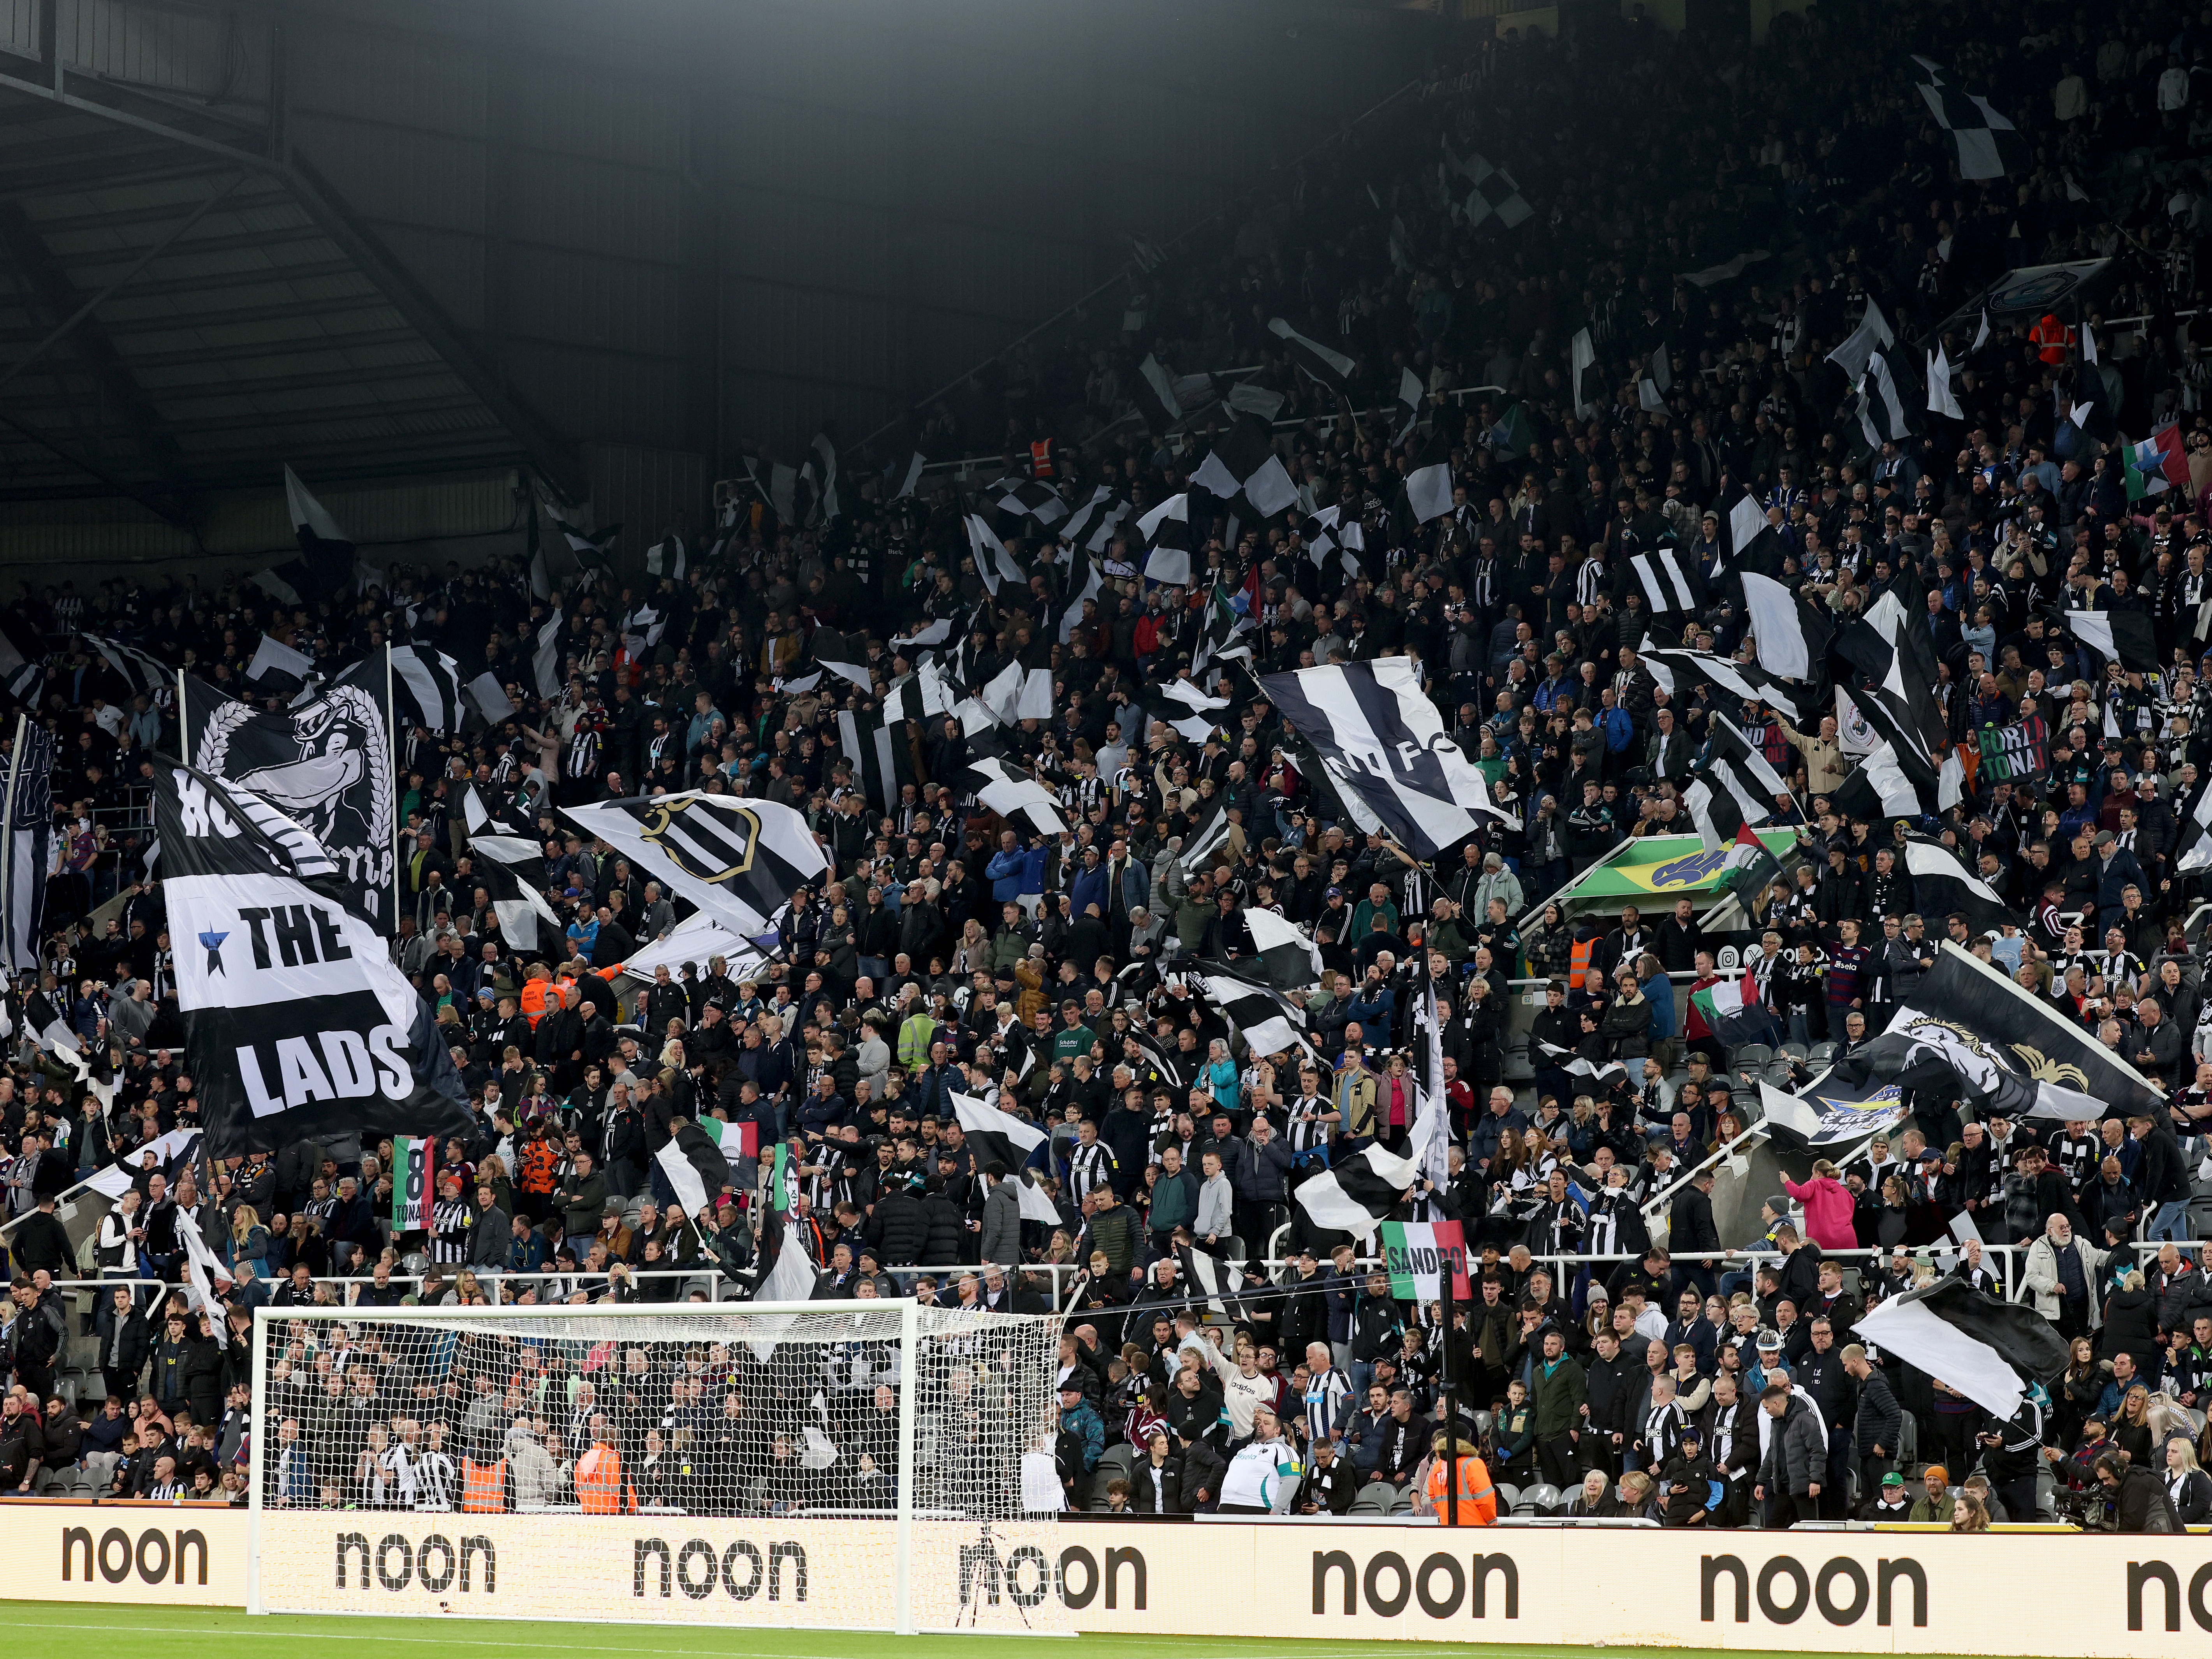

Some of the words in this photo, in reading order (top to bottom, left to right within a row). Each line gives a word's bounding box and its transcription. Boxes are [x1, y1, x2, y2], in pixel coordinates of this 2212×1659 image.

[1765, 746, 1787, 762] OLE
[238, 904, 352, 969] THE
[1841, 963, 1857, 971] sela
[236, 1024, 414, 1118] LADS
[407, 1149, 424, 1201] 8
[396, 1203, 430, 1223] TONALI
[1232, 1382, 1256, 1395] adidas
[1648, 1428, 1661, 1436] sela
[1716, 1426, 1731, 1434] sela
[63, 1527, 207, 1584] noon
[336, 1533, 496, 1593] noon
[634, 1540, 805, 1601] noon
[959, 1545, 1146, 1610] noon
[1313, 1550, 1518, 1619] noon
[1701, 1555, 1927, 1626] noon
